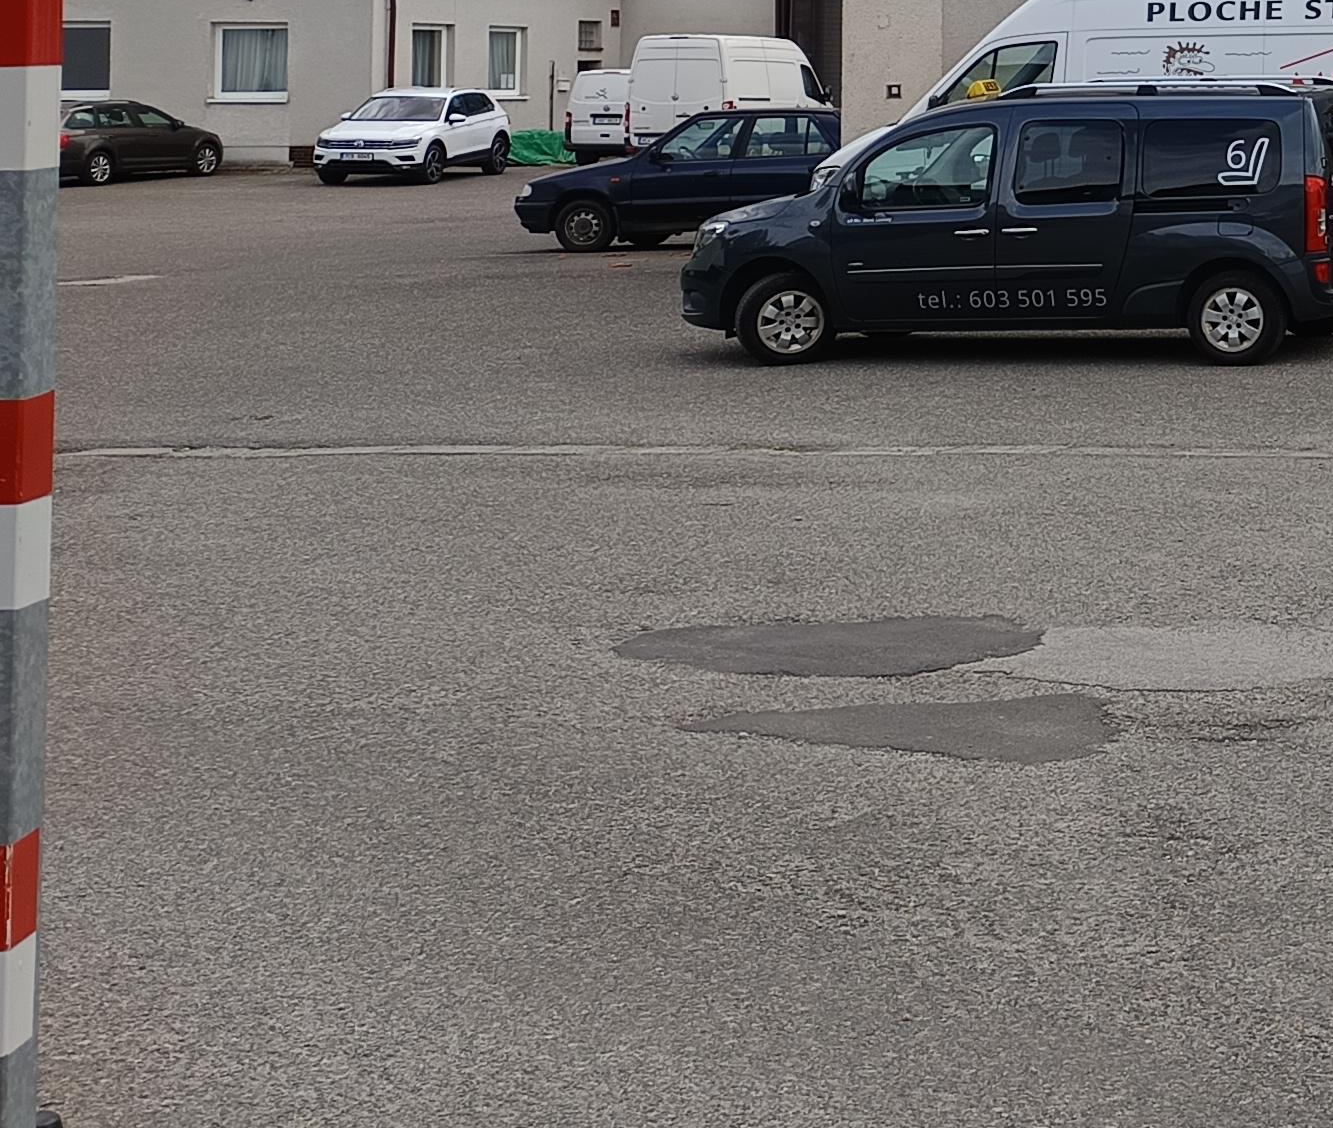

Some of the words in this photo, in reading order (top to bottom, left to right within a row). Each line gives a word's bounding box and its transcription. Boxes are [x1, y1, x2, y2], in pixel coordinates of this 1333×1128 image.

[1226, 139, 1247, 169] 6
[917, 290, 962, 309] tel.:
[969, 290, 1010, 309] 603
[1018, 289, 1056, 308] 501
[1066, 288, 1107, 307] 595
